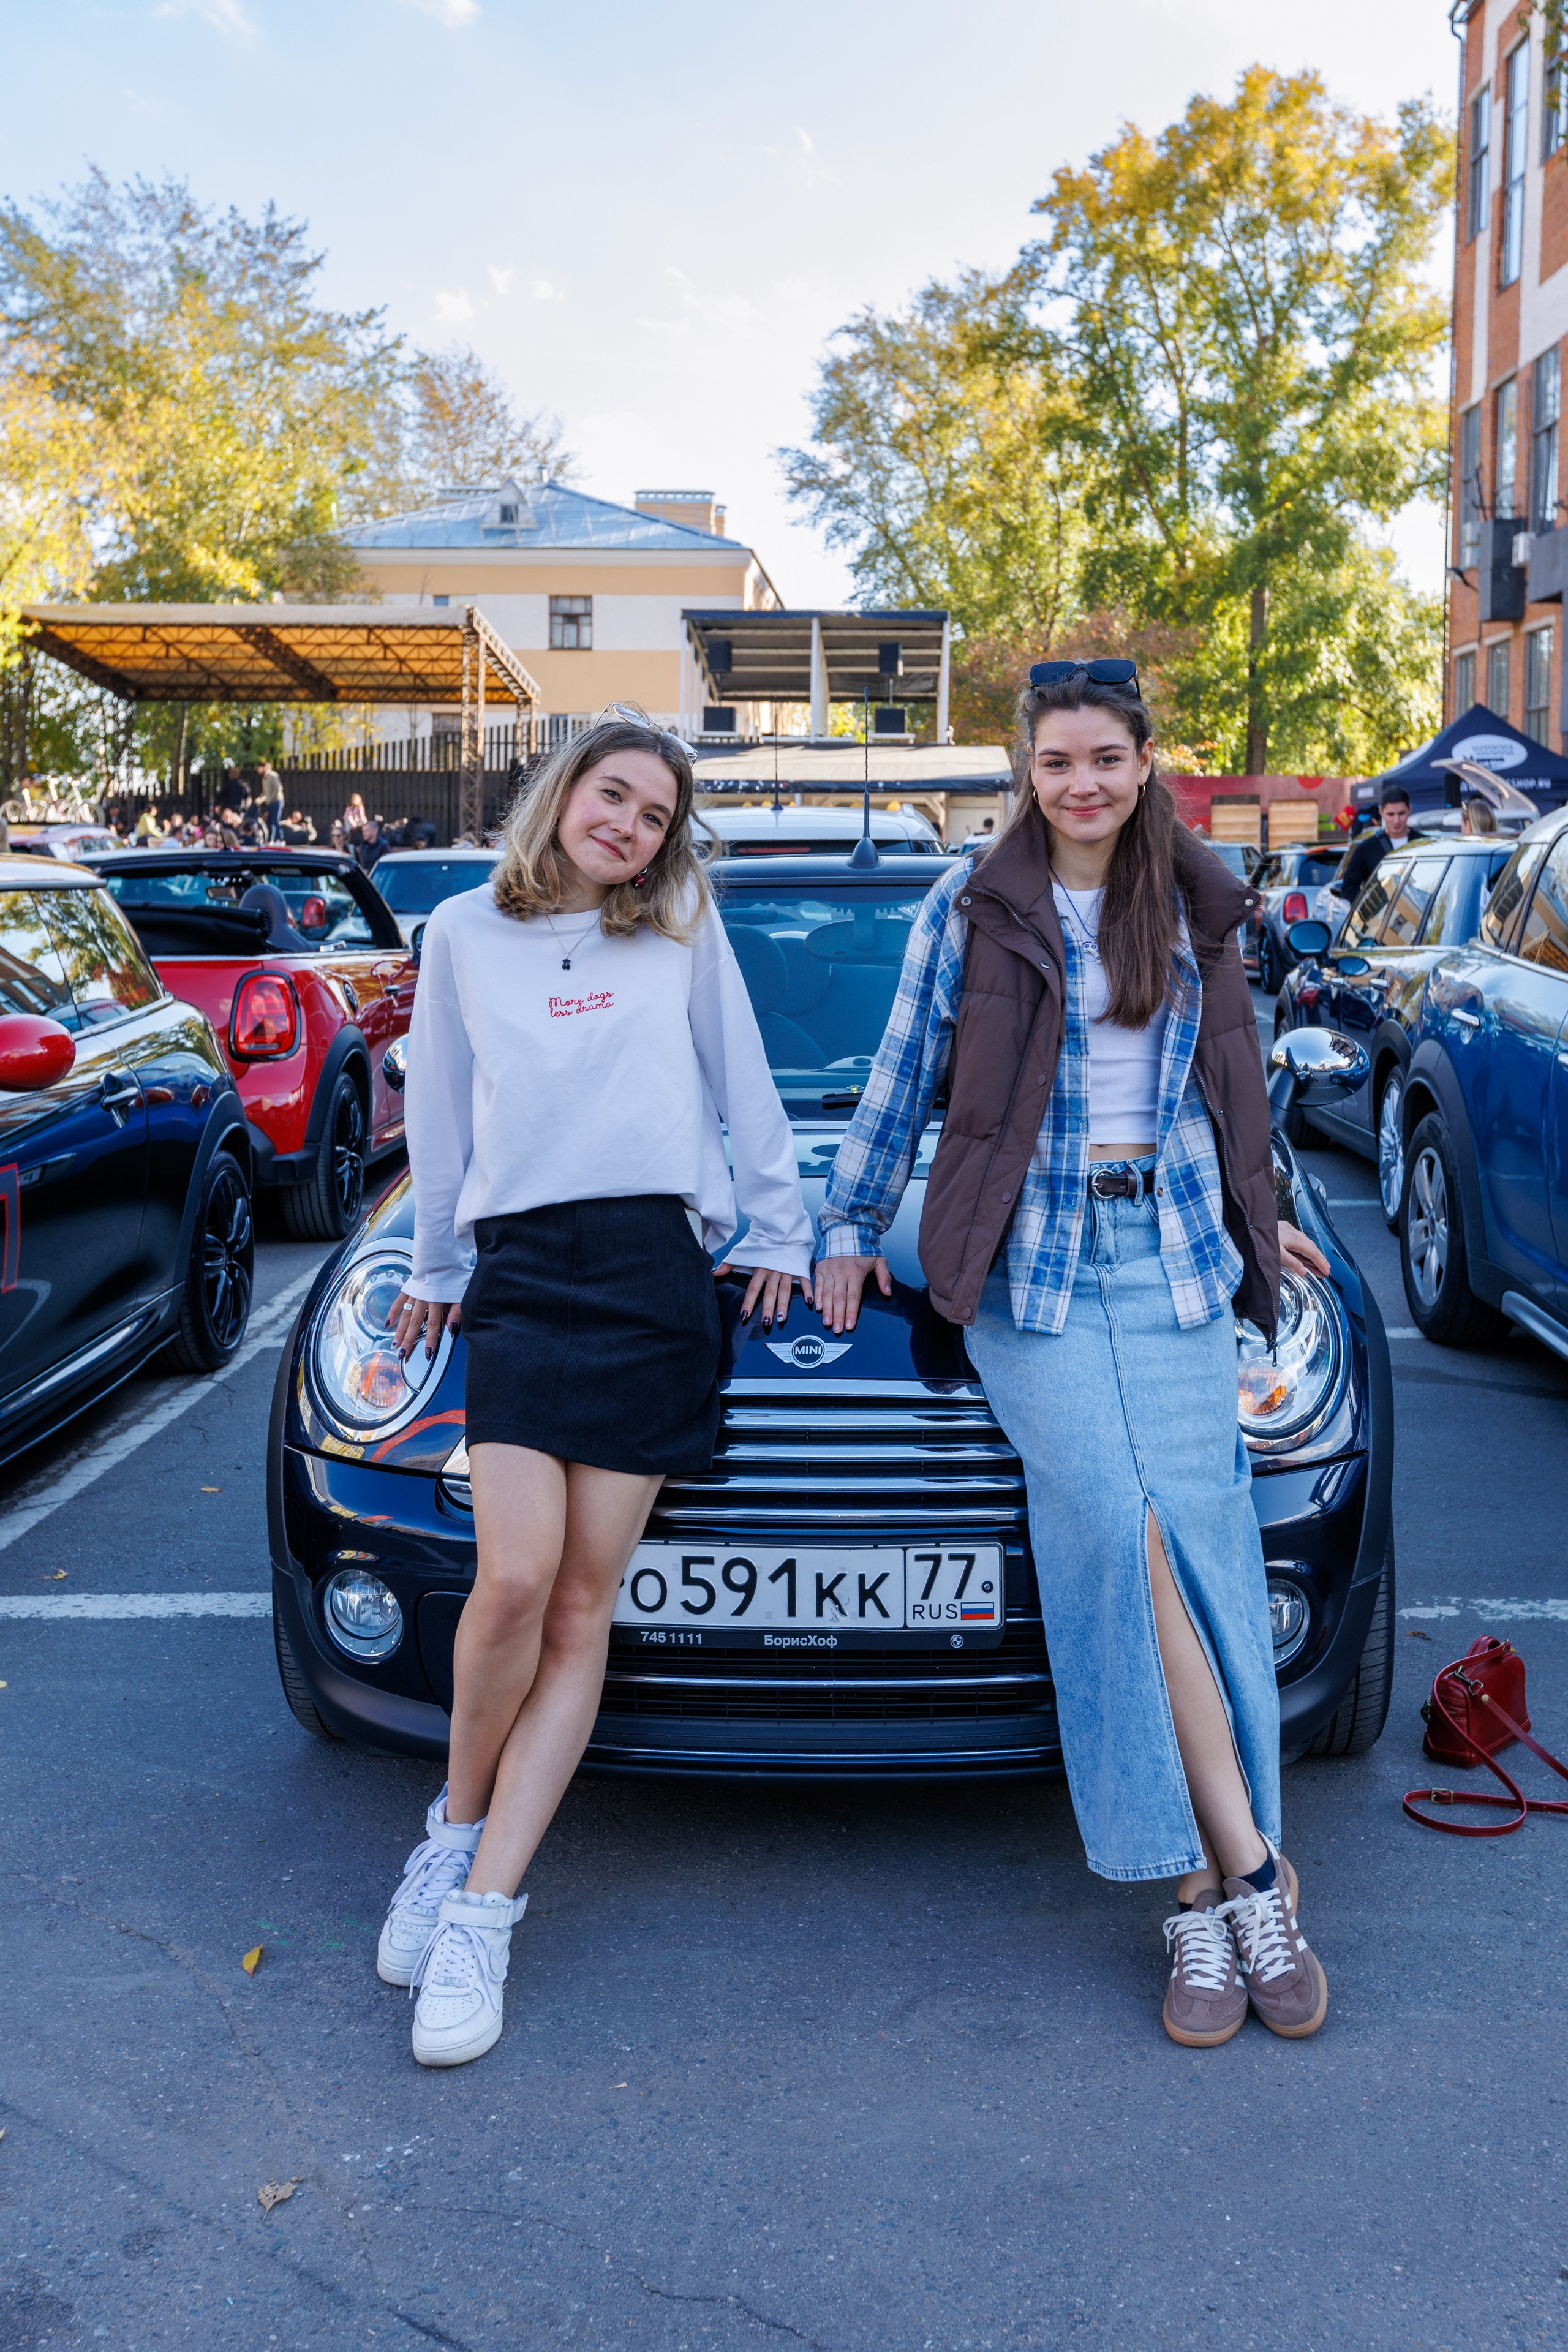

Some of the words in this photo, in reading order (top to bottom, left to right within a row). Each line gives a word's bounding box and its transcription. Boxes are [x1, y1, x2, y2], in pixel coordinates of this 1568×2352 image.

[549, 997, 584, 1008] More
[587, 992, 614, 1003] dogs
[550, 1008, 573, 1017] less
[576, 1003, 614, 1014] drama
[794, 1346, 821, 1355] MINI
[914, 1553, 976, 1600] 77
[913, 1604, 958, 1620] RUS
[641, 1631, 666, 1643] 745
[670, 1633, 702, 1645] 1111
[764, 1634, 838, 1648] БорисХоф
